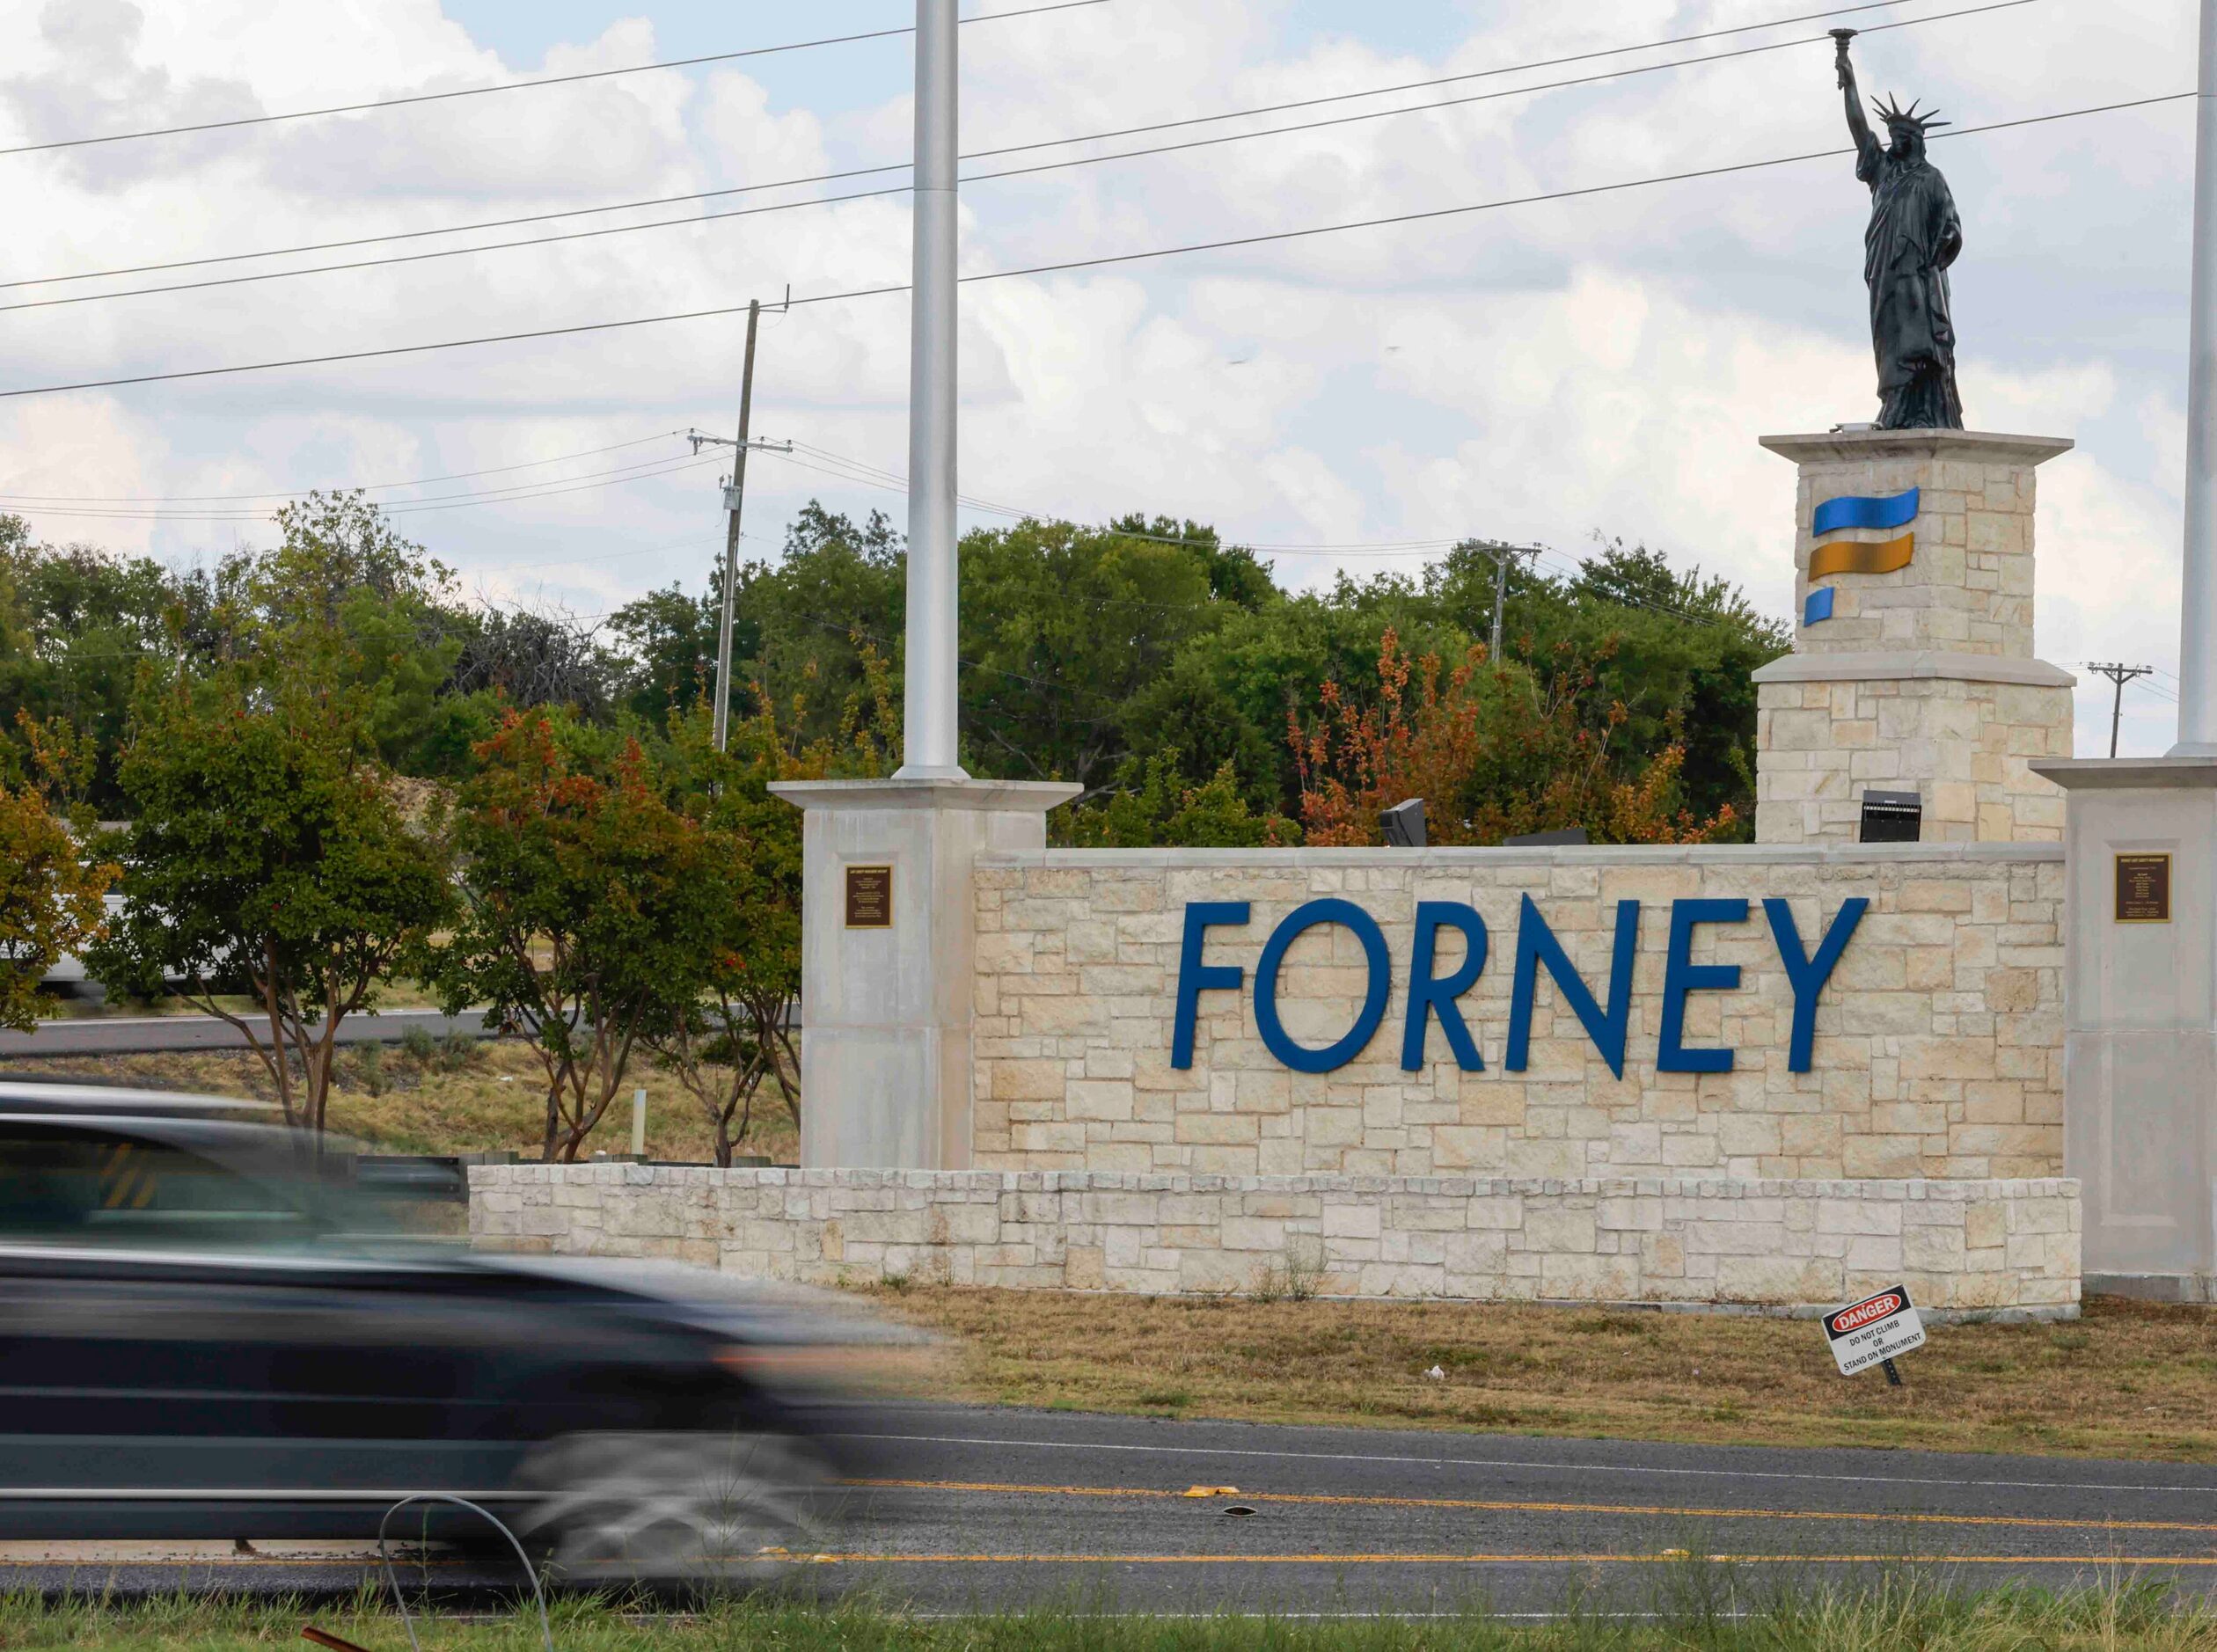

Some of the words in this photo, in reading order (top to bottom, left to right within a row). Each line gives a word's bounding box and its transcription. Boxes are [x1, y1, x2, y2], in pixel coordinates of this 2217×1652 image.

[1171, 894, 1869, 1079] FORNEY
[1839, 1297, 1895, 1329] DANGER
[1849, 1337, 1860, 1347] DO
[1861, 1330, 1875, 1341] NOT
[1877, 1319, 1899, 1334] CLIMB
[1873, 1337, 1884, 1347] OR
[1844, 1356, 1867, 1371] STAND
[1868, 1350, 1879, 1361] ON
[1879, 1332, 1921, 1356] MONUMENT
